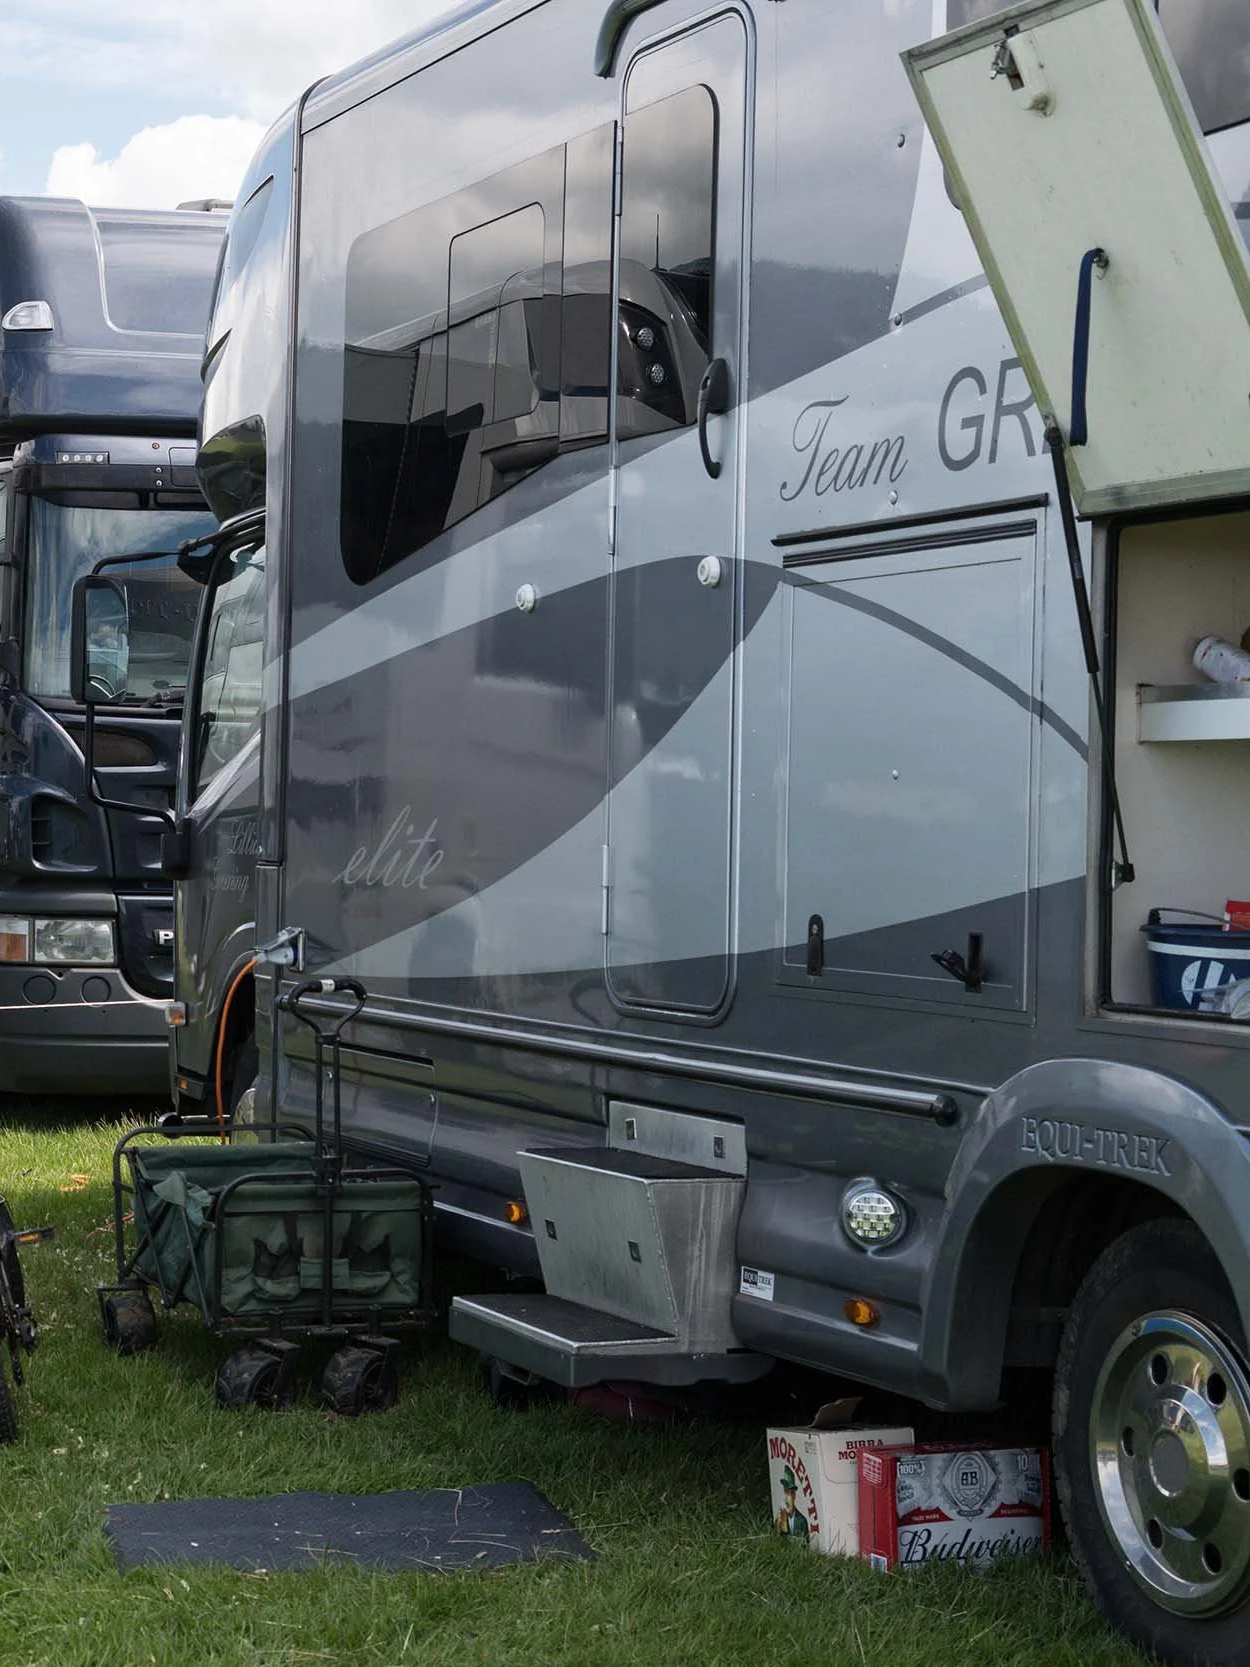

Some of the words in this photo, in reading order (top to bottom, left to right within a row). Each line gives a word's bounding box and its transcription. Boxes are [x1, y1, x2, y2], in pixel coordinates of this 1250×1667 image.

[779, 394, 909, 502] Team
[937, 356, 1051, 472] GR
[332, 804, 444, 889] elite
[1020, 1116, 1173, 1177] EQUI-TREK
[846, 1439, 884, 1449] BIRRA
[768, 1436, 820, 1534] MORETTI
[961, 1471, 978, 1487] AB
[899, 1527, 1043, 1565] Budweiser
